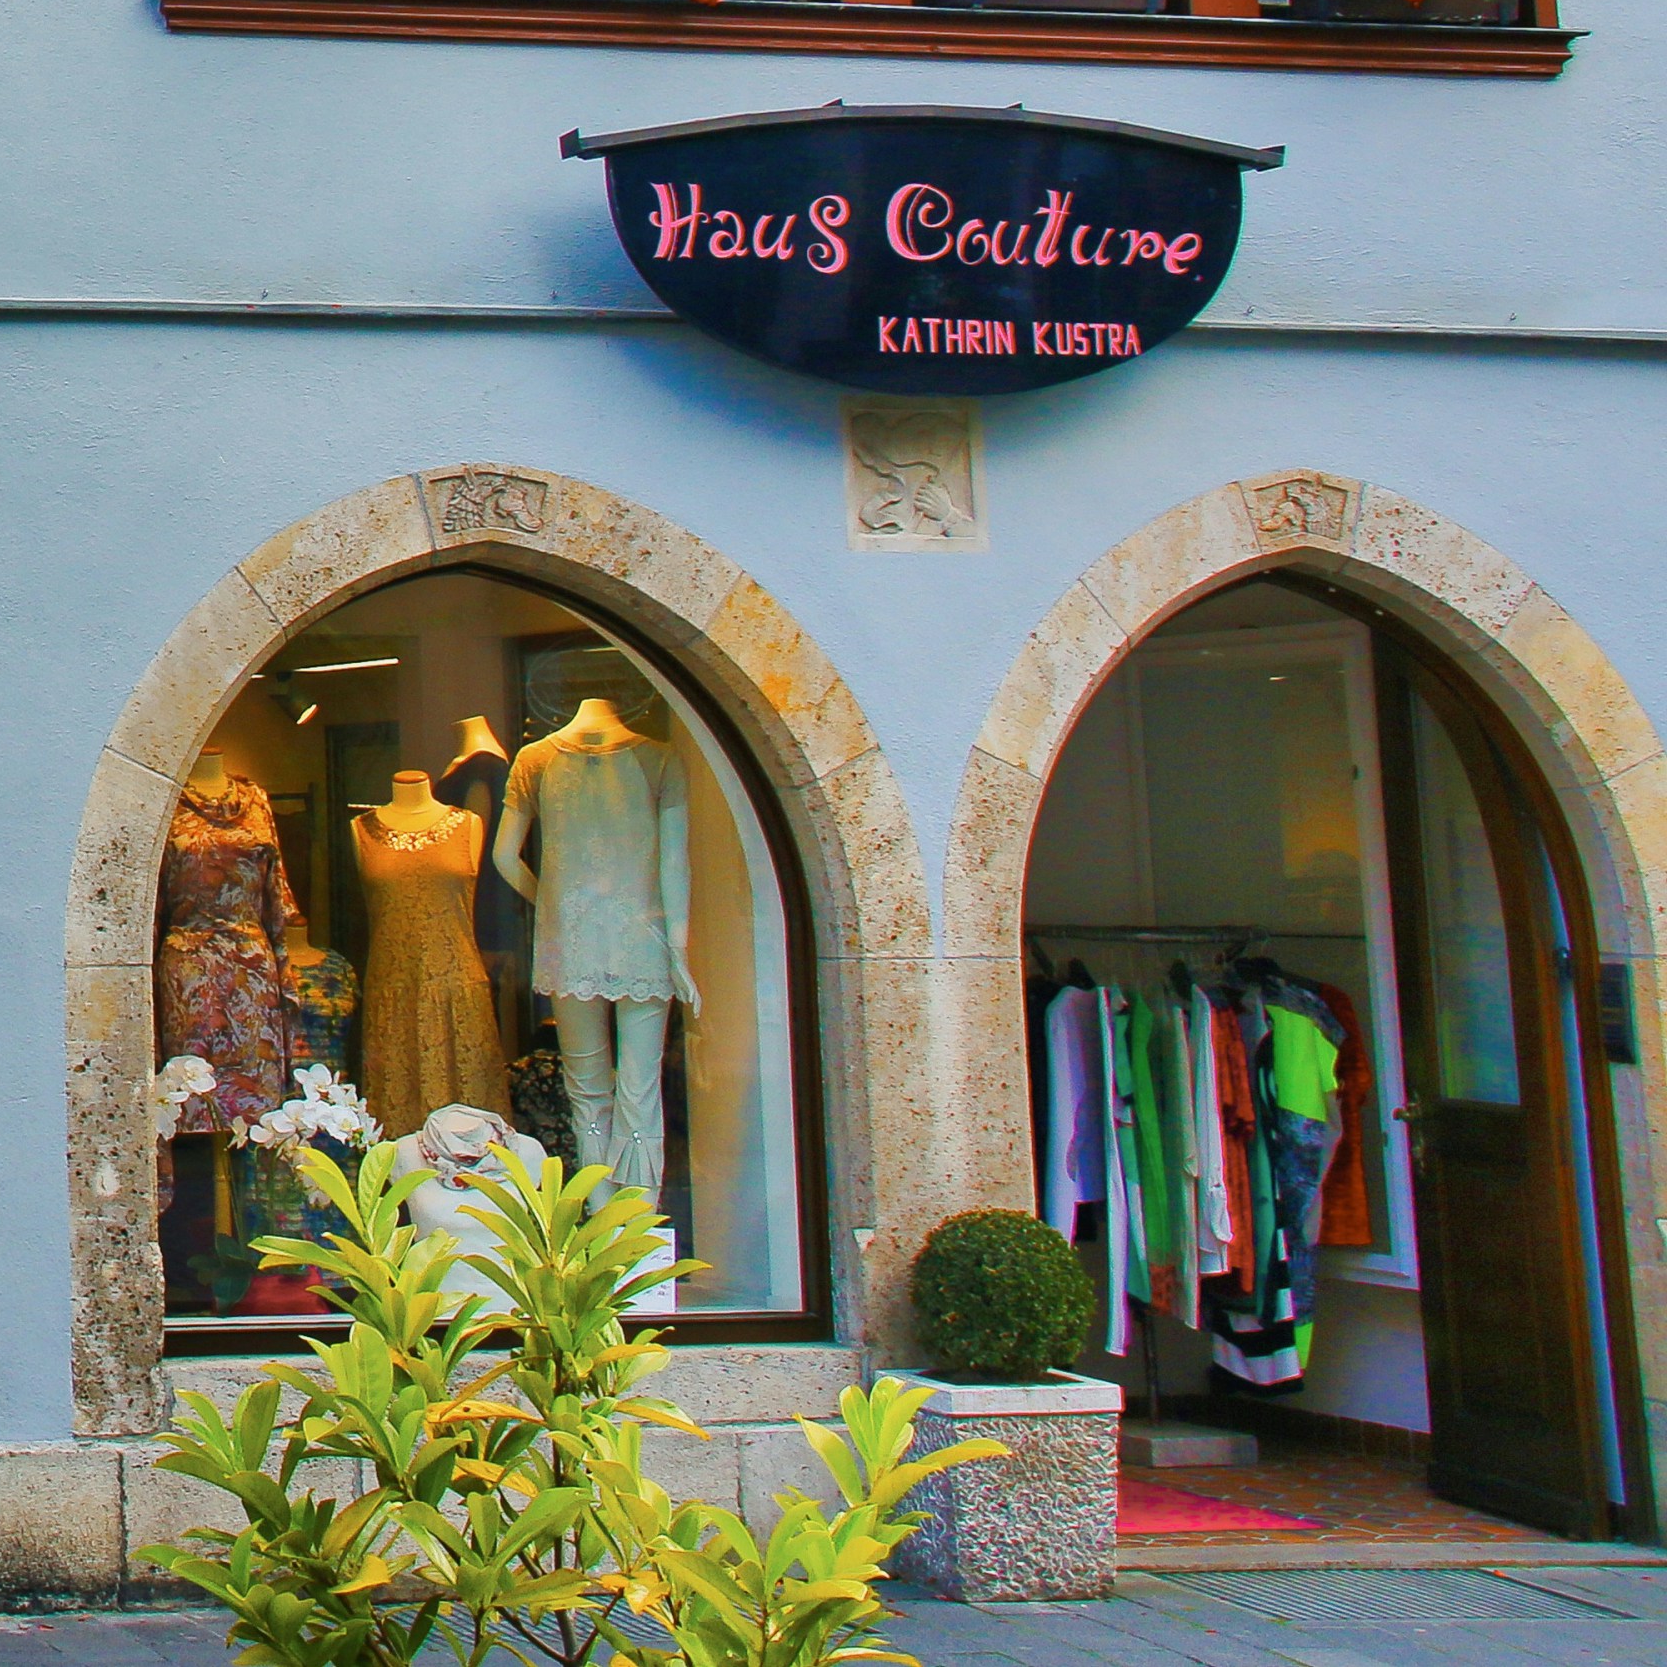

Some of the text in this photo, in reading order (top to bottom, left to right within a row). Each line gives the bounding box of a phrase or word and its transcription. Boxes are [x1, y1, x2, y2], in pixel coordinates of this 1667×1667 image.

[648, 181, 1204, 275] Haus Couture
[877, 315, 1142, 356] KATHRIN KUSTRA
